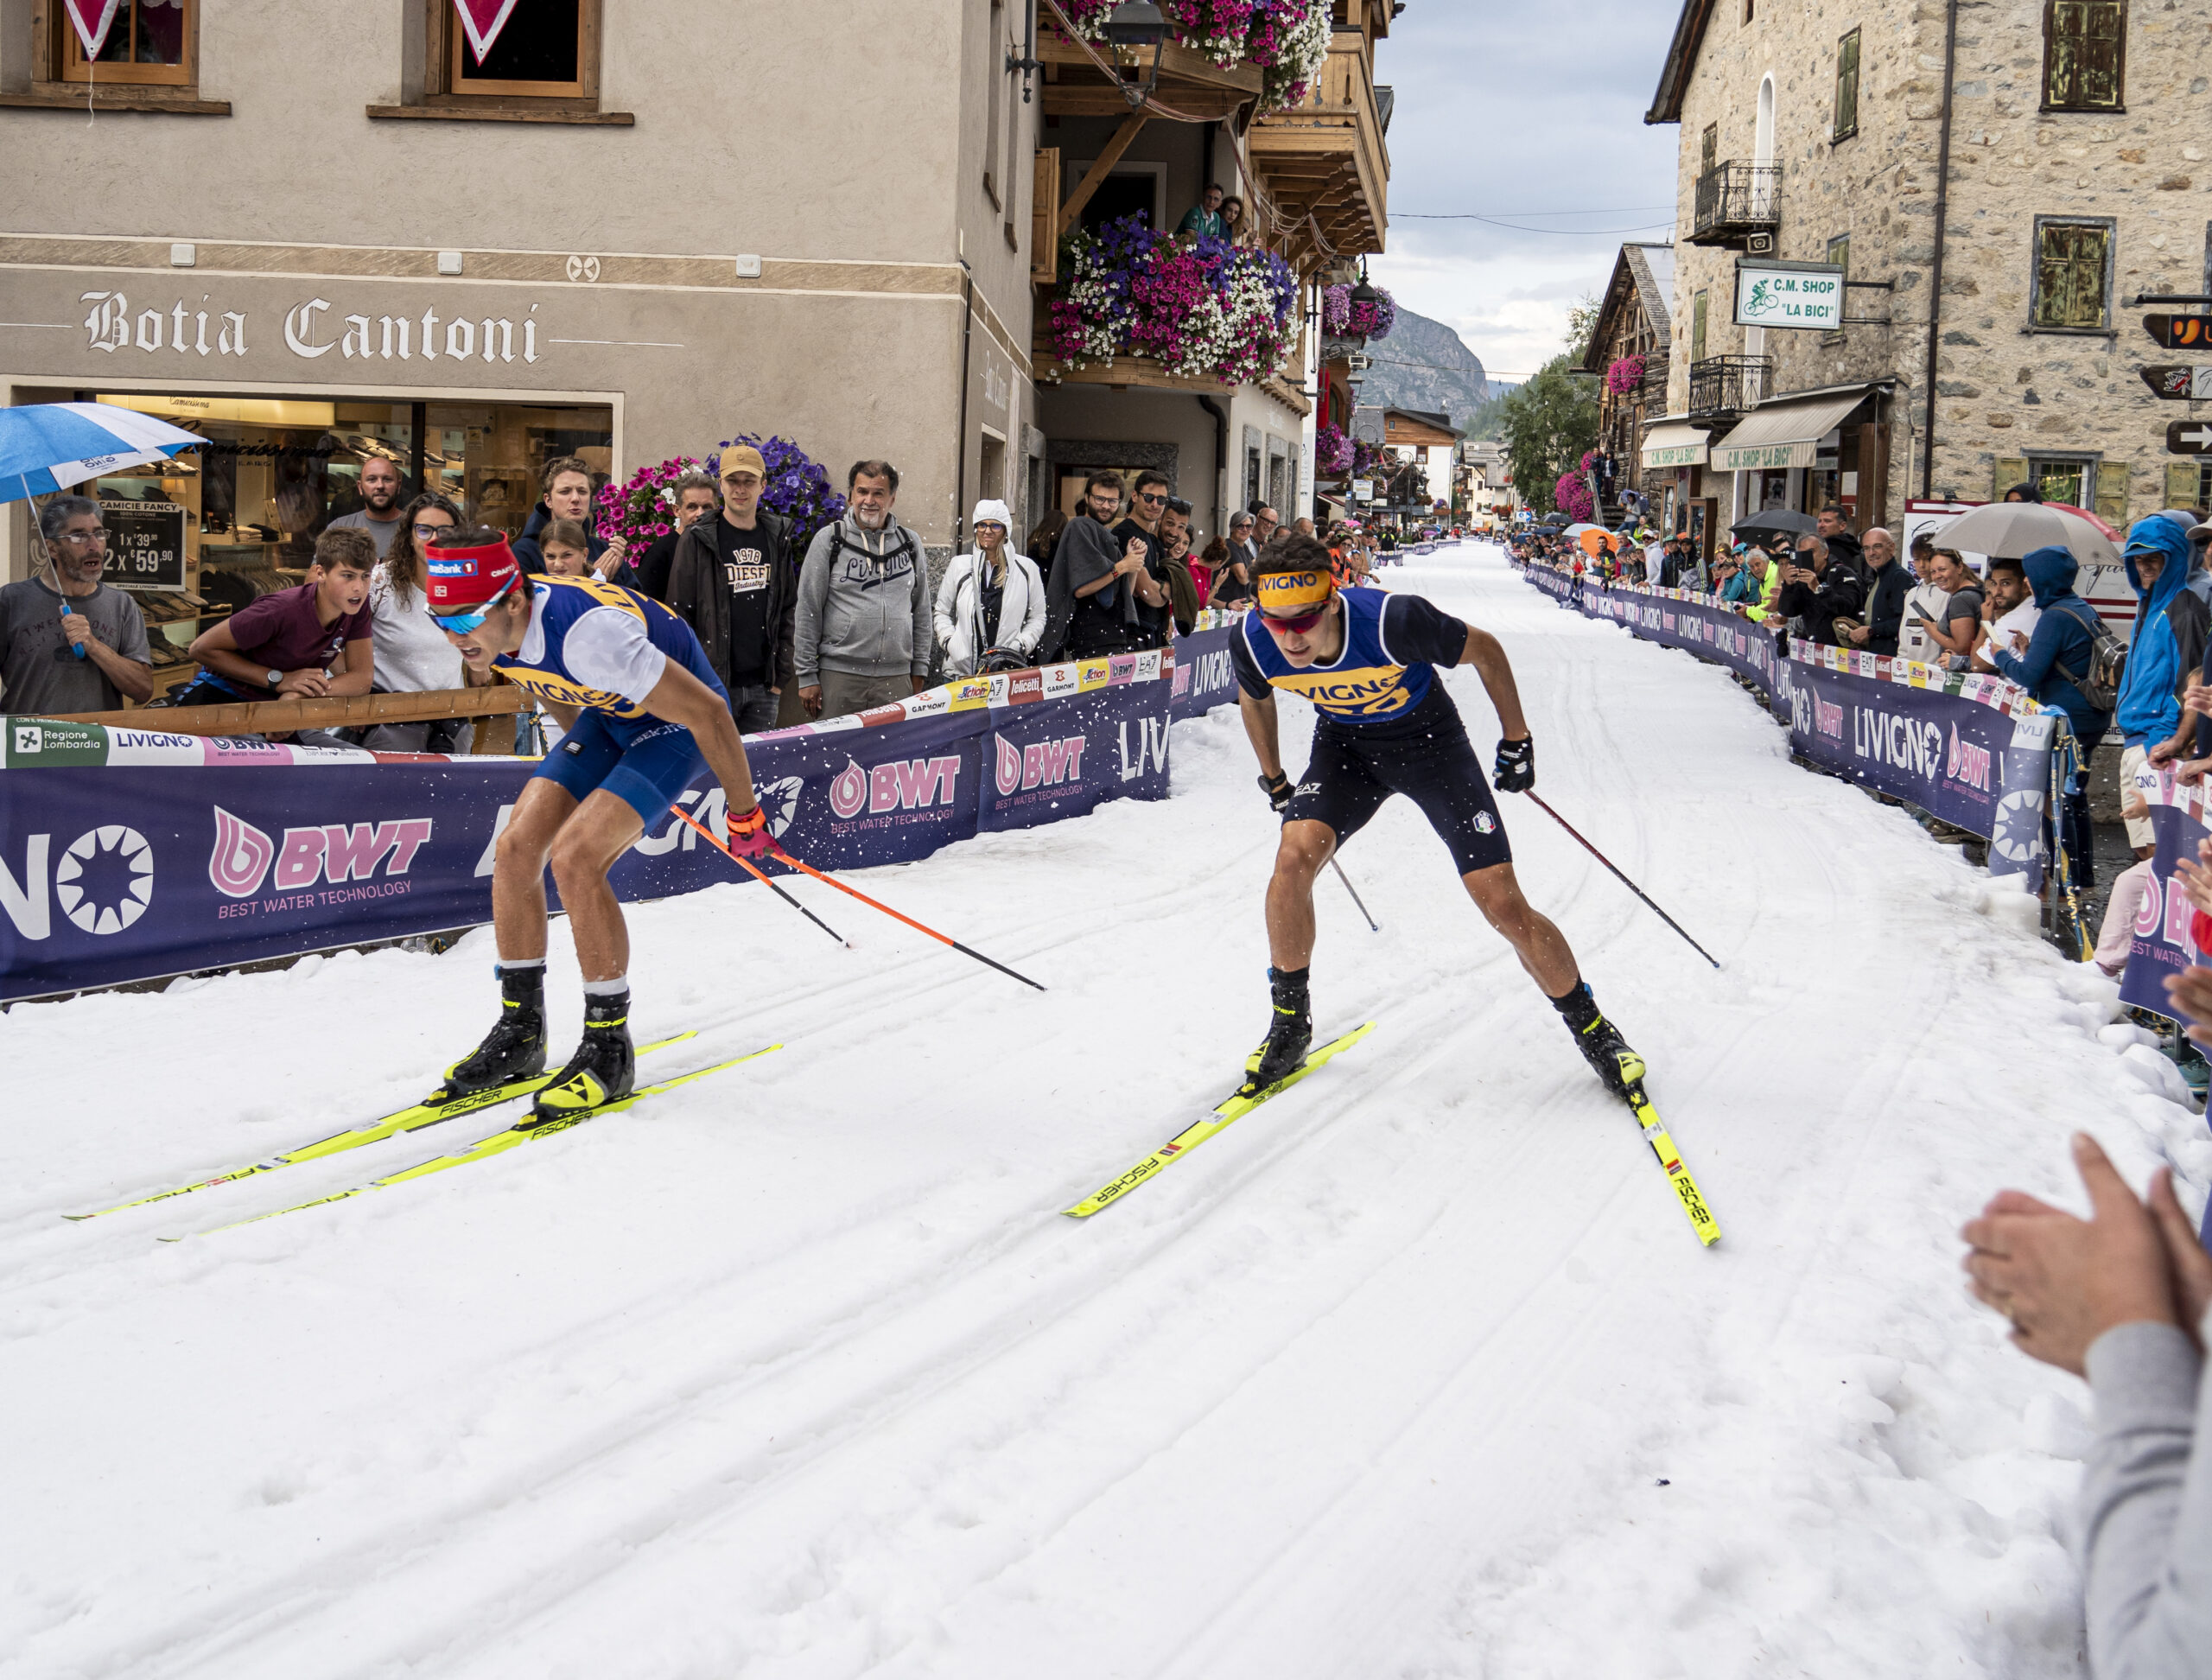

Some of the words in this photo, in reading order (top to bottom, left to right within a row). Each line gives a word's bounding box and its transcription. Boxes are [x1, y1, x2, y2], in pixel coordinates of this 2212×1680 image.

[1774, 279, 1798, 292] C.M.
[1802, 280, 1834, 293] SHOP
[79, 290, 249, 357] Botia
[284, 297, 539, 364] Cantoni
[1662, 449, 1674, 464] SHOP
[1742, 449, 1759, 467] SHOP
[99, 501, 141, 510] CAMICIE
[119, 533, 124, 546] 1
[126, 537, 132, 546] x
[104, 549, 114, 570] 2
[118, 555, 126, 571] x
[733, 548, 761, 564] 1978
[491, 564, 513, 577] CRAFT
[734, 578, 766, 591] Industry
[1679, 614, 1701, 643] LIVIGNO
[1118, 664, 1134, 676] BWT
[1193, 650, 1232, 697] LIVIGNO
[1011, 677, 1040, 696] felicetti
[1047, 683, 1076, 692] GARMONT
[912, 702, 946, 713] GARMONT
[1821, 701, 1843, 740] BWT
[44, 730, 88, 741] Regione
[44, 740, 100, 749] Lombardia
[117, 733, 194, 748] LIVIGNO
[1854, 705, 1942, 780] LIVIGNO
[1021, 735, 1086, 791] BWT
[1959, 740, 1991, 792] BWT
[869, 754, 961, 814] BWT
[995, 799, 1012, 811] BEST
[1014, 795, 1036, 807] WATER
[1037, 784, 1084, 801] TECHNOLOGY
[831, 821, 857, 834] BEST
[860, 817, 893, 830] WATER
[894, 808, 955, 826] TECHNOLOGY
[274, 818, 433, 890] BWT
[219, 901, 258, 919] BEST
[264, 894, 315, 913] WATER
[319, 880, 411, 906] TECHNOLOGY
[2132, 939, 2152, 958] EST
[439, 1089, 503, 1117] FISCHER
[531, 1110, 594, 1140] FISCHER
[1096, 1157, 1160, 1203] FISCHER
[1675, 1176, 1711, 1227] FISCHER
